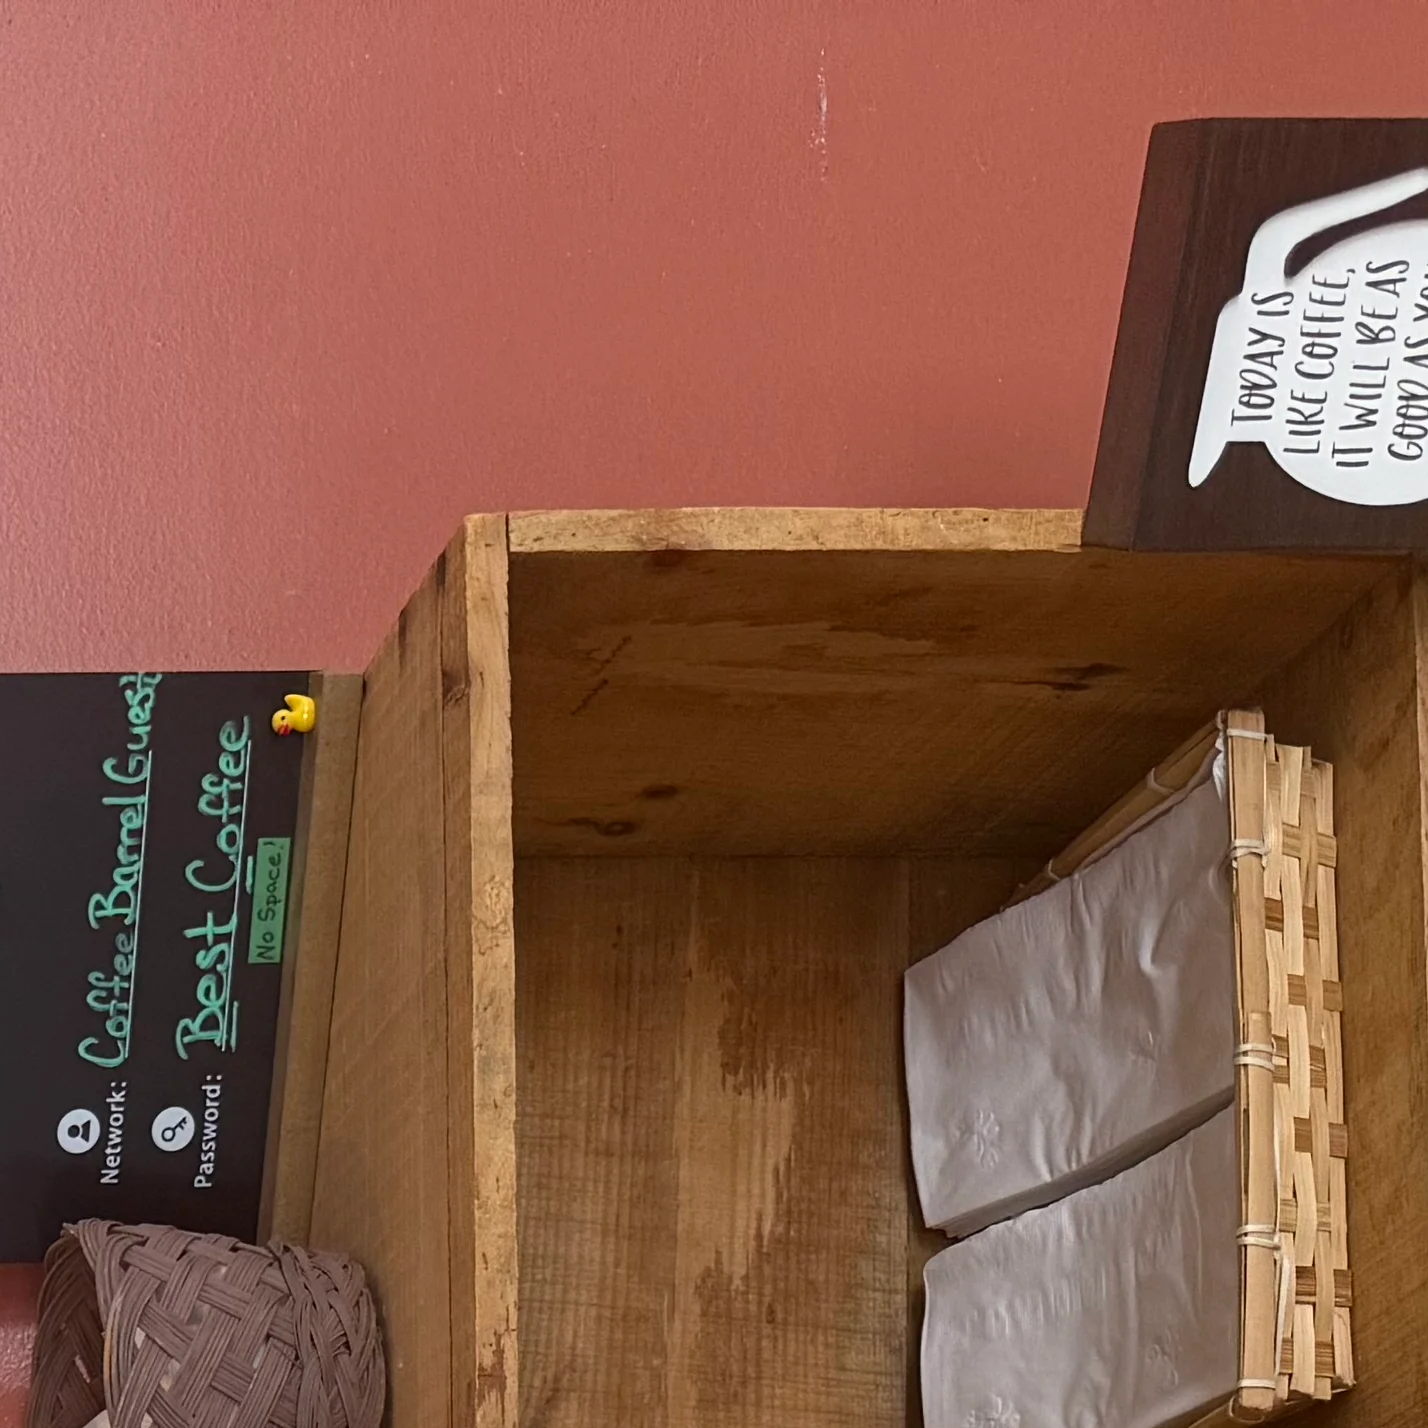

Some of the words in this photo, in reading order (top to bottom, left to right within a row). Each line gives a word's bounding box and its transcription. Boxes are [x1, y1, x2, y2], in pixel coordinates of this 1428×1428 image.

[1251, 291, 1294, 317] IS
[1354, 304, 1398, 344] BE
[1364, 259, 1410, 298] AS
[1294, 269, 1356, 380] COFFEE,
[1230, 327, 1286, 427] TODAY
[1282, 389, 1328, 454] LIKE
[1339, 357, 1390, 431] WILL
[1387, 379, 1428, 461] GOOD
[1331, 441, 1373, 468] IT
[101, 672, 162, 784] Guest
[184, 715, 250, 893] Coffee
[87, 795, 146, 929] Barrel
[256, 841, 284, 922] Space!
[175, 912, 237, 1060] Best
[255, 932, 276, 961] No
[77, 932, 133, 1068] Coffee
[99, 1081, 128, 1184] Network:
[193, 1074, 224, 1188] Password:
